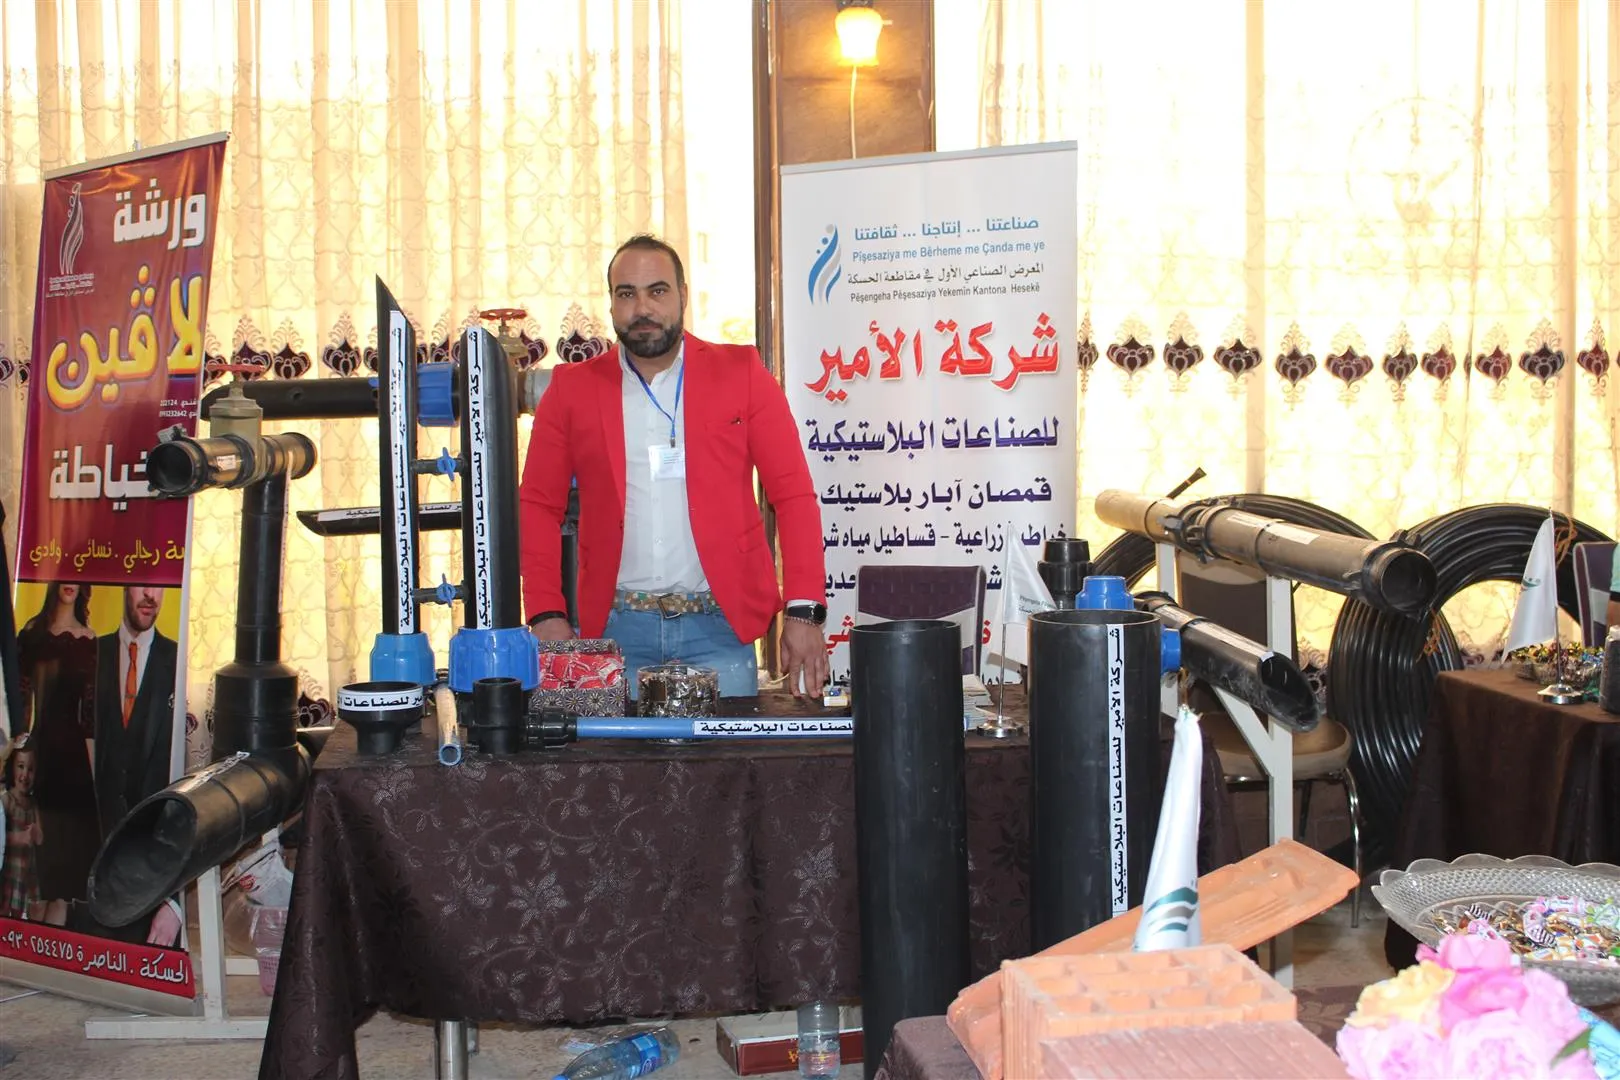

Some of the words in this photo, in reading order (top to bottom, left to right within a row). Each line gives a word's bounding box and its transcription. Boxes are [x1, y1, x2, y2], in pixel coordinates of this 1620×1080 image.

[113, 178, 206, 250] ورشة
[986, 216, 1039, 232] صناعتنا
[855, 224, 898, 241] ثقافتنا
[902, 250, 918, 258] me
[965, 246, 980, 254] me
[982, 242, 1014, 256] Çanda
[1016, 243, 1031, 252] me
[1033, 241, 1045, 254] ye
[848, 272, 883, 284] الحسكة
[884, 270, 920, 281] مقاطعة
[964, 264, 1007, 283] الصناعي
[1009, 262, 1044, 278] المعرض
[972, 285, 1007, 296] Kantona
[468, 331, 482, 396] شركة
[804, 320, 923, 402] الأمير
[934, 312, 1059, 391] شركة
[805, 419, 934, 461] البلاستيكية
[942, 416, 1059, 448] للصناعات
[473, 451, 486, 537] للصناعات
[820, 482, 912, 512] بلاستيك
[915, 479, 962, 511] آبار
[968, 476, 1053, 509] قمصان
[842, 526, 871, 554] مياه
[873, 523, 936, 554] قساطيل
[955, 522, 1004, 553] زراعية
[123, 540, 160, 573] رجالي
[477, 542, 491, 627] البلاستيكي
[1109, 628, 1123, 687] شركة
[344, 696, 408, 707] للصناعات
[700, 721, 783, 735] البلاستيكية
[788, 721, 853, 732] لصناعات
[1112, 736, 1123, 813] للصناعات
[1114, 817, 1127, 906] البلاستيكية
[140, 952, 189, 984] الحسكة
